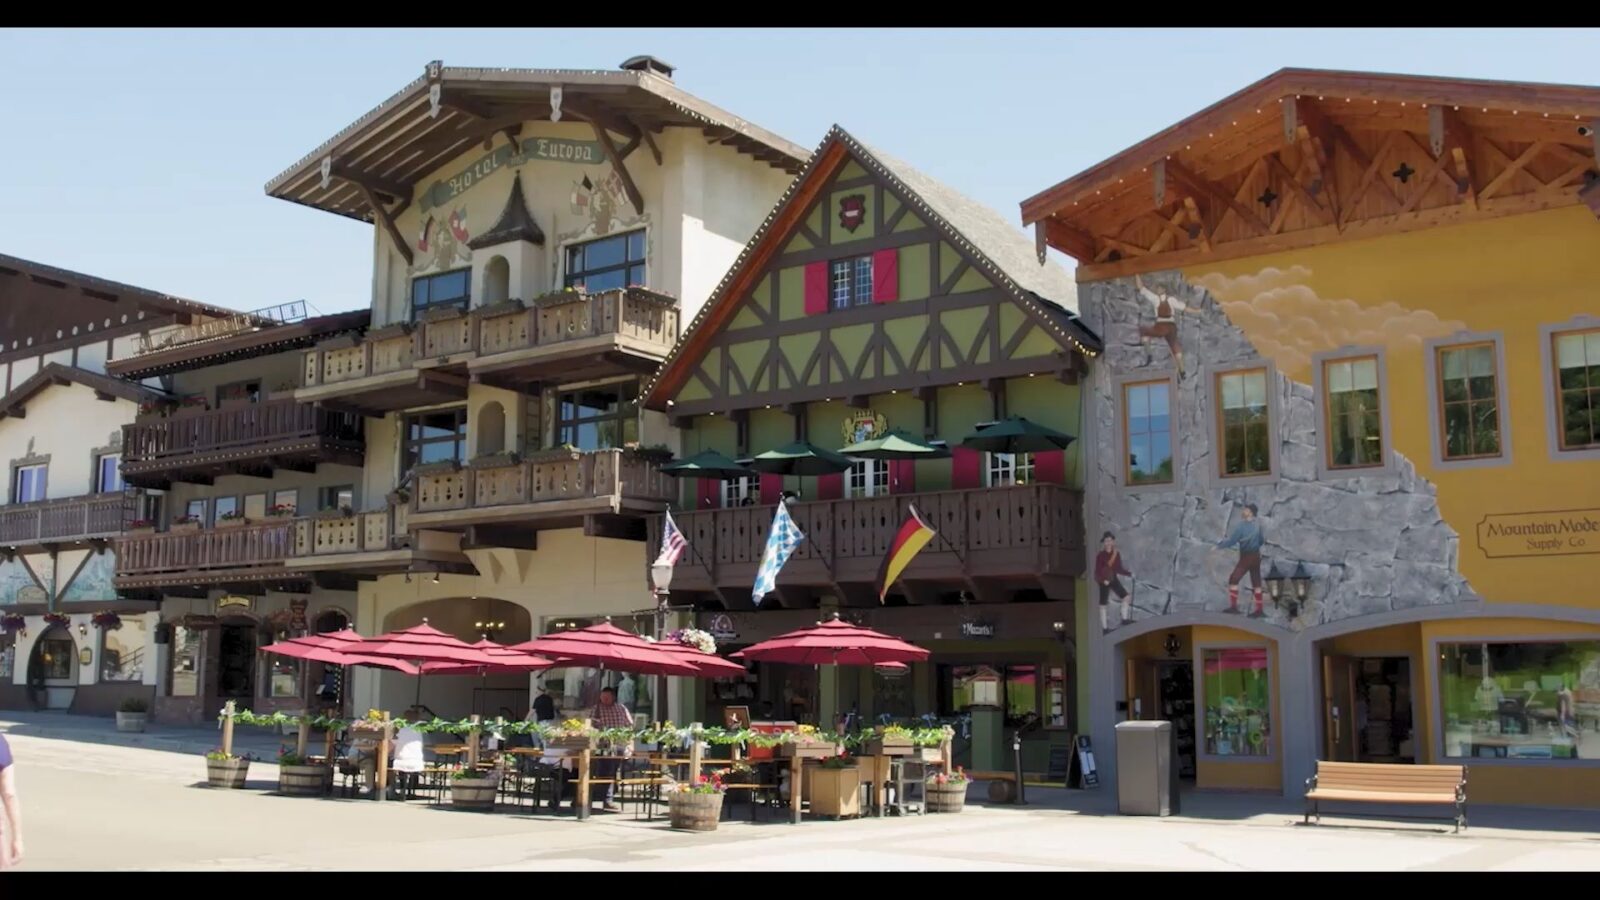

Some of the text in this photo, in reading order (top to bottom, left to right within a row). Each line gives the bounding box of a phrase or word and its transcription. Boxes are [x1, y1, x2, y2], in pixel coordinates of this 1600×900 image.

[450, 139, 592, 196] Hotel Europa
[1487, 522, 1557, 538] Mountain
[1526, 537, 1563, 551] Supply
